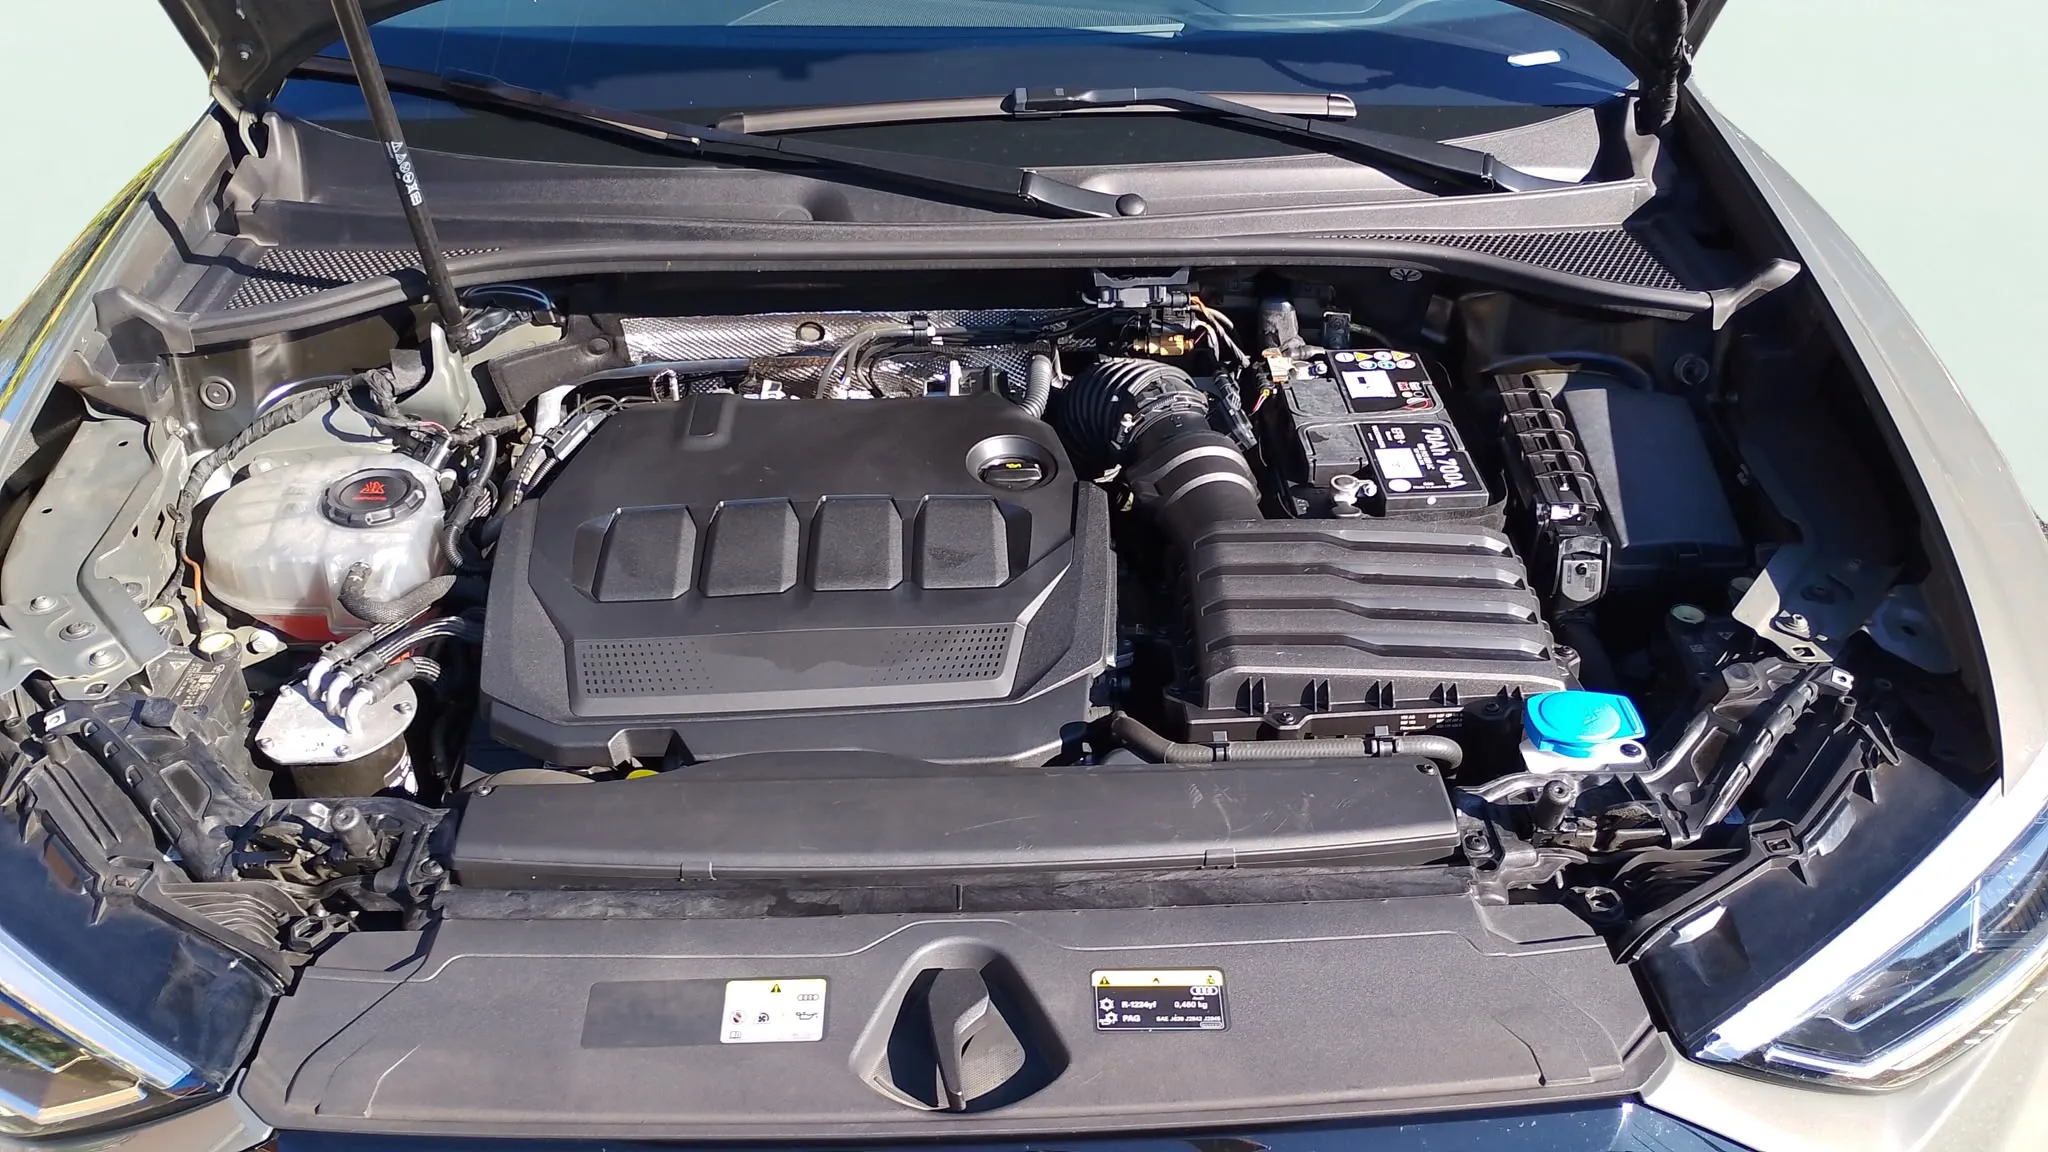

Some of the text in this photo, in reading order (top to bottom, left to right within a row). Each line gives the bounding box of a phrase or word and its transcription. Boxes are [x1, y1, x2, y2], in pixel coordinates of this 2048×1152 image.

[1421, 427, 1451, 456] 70Ah
[1436, 458, 1468, 488] 700A
[1121, 1001, 1157, 1009] R-1234yf
[1197, 1001, 1208, 1009] kg
[1122, 1014, 1141, 1022] PAG
